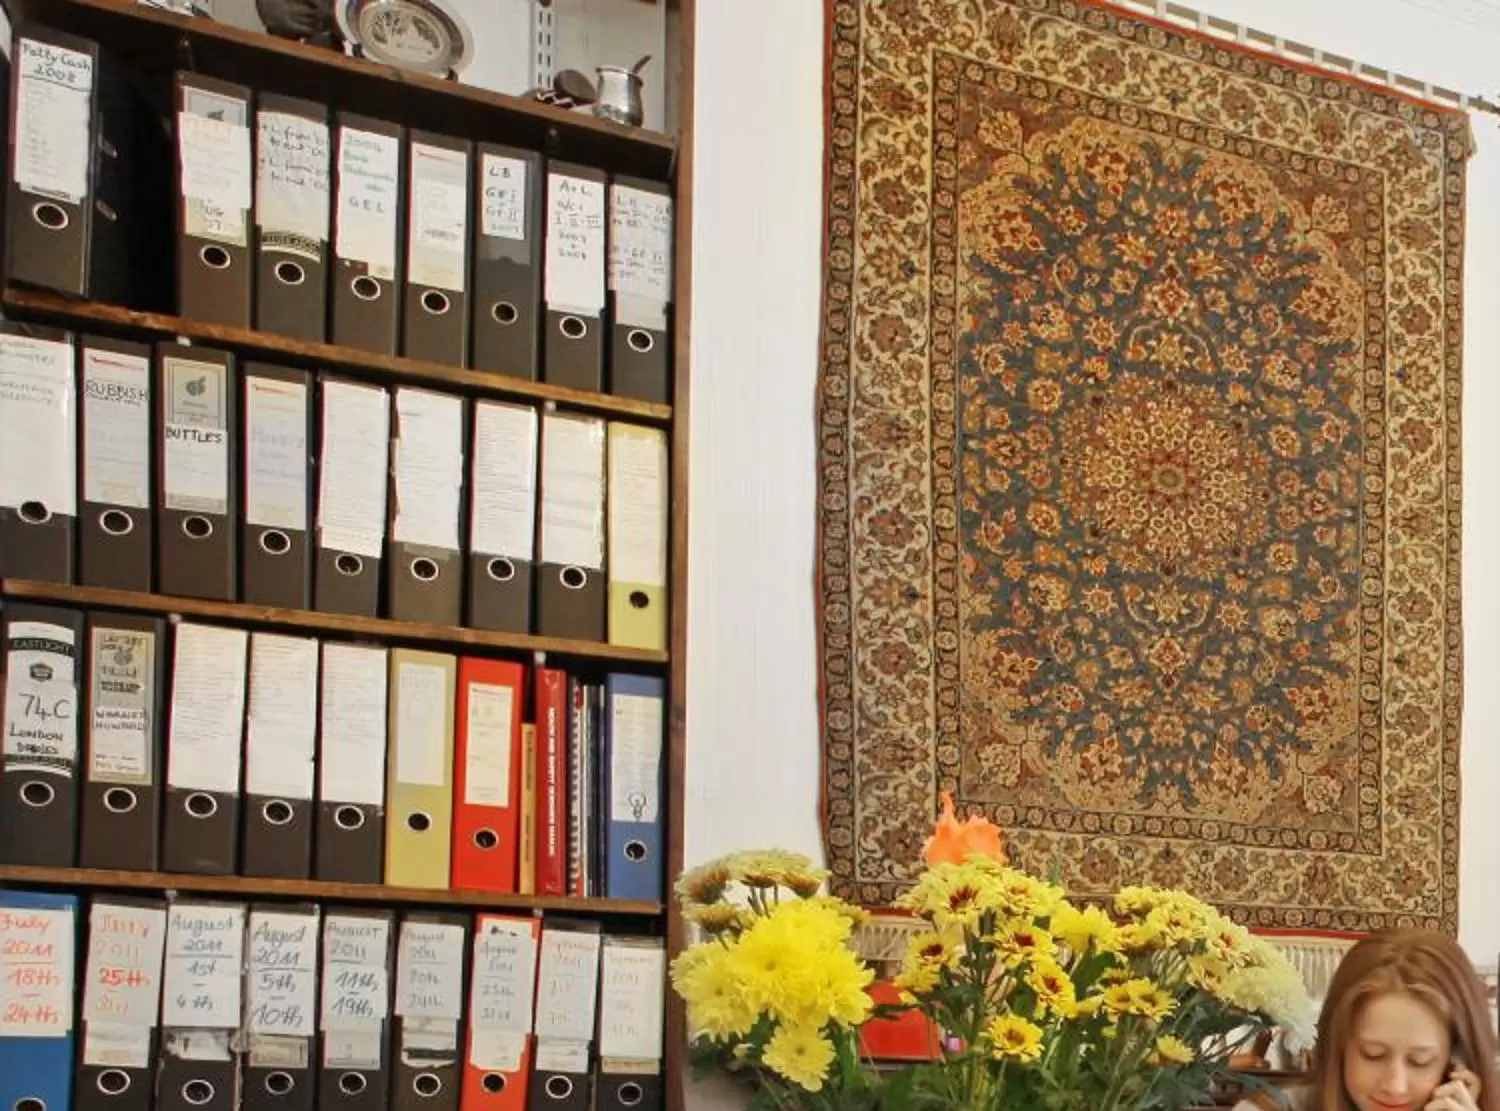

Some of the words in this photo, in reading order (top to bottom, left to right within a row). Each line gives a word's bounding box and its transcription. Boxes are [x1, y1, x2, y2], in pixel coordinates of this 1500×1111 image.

[86, 380, 150, 401] RUBBISH
[18, 692, 71, 721] 74C
[171, 914, 234, 940] August
[253, 925, 305, 949] August
[185, 960, 217, 977] 1st
[257, 974, 297, 993] 5th
